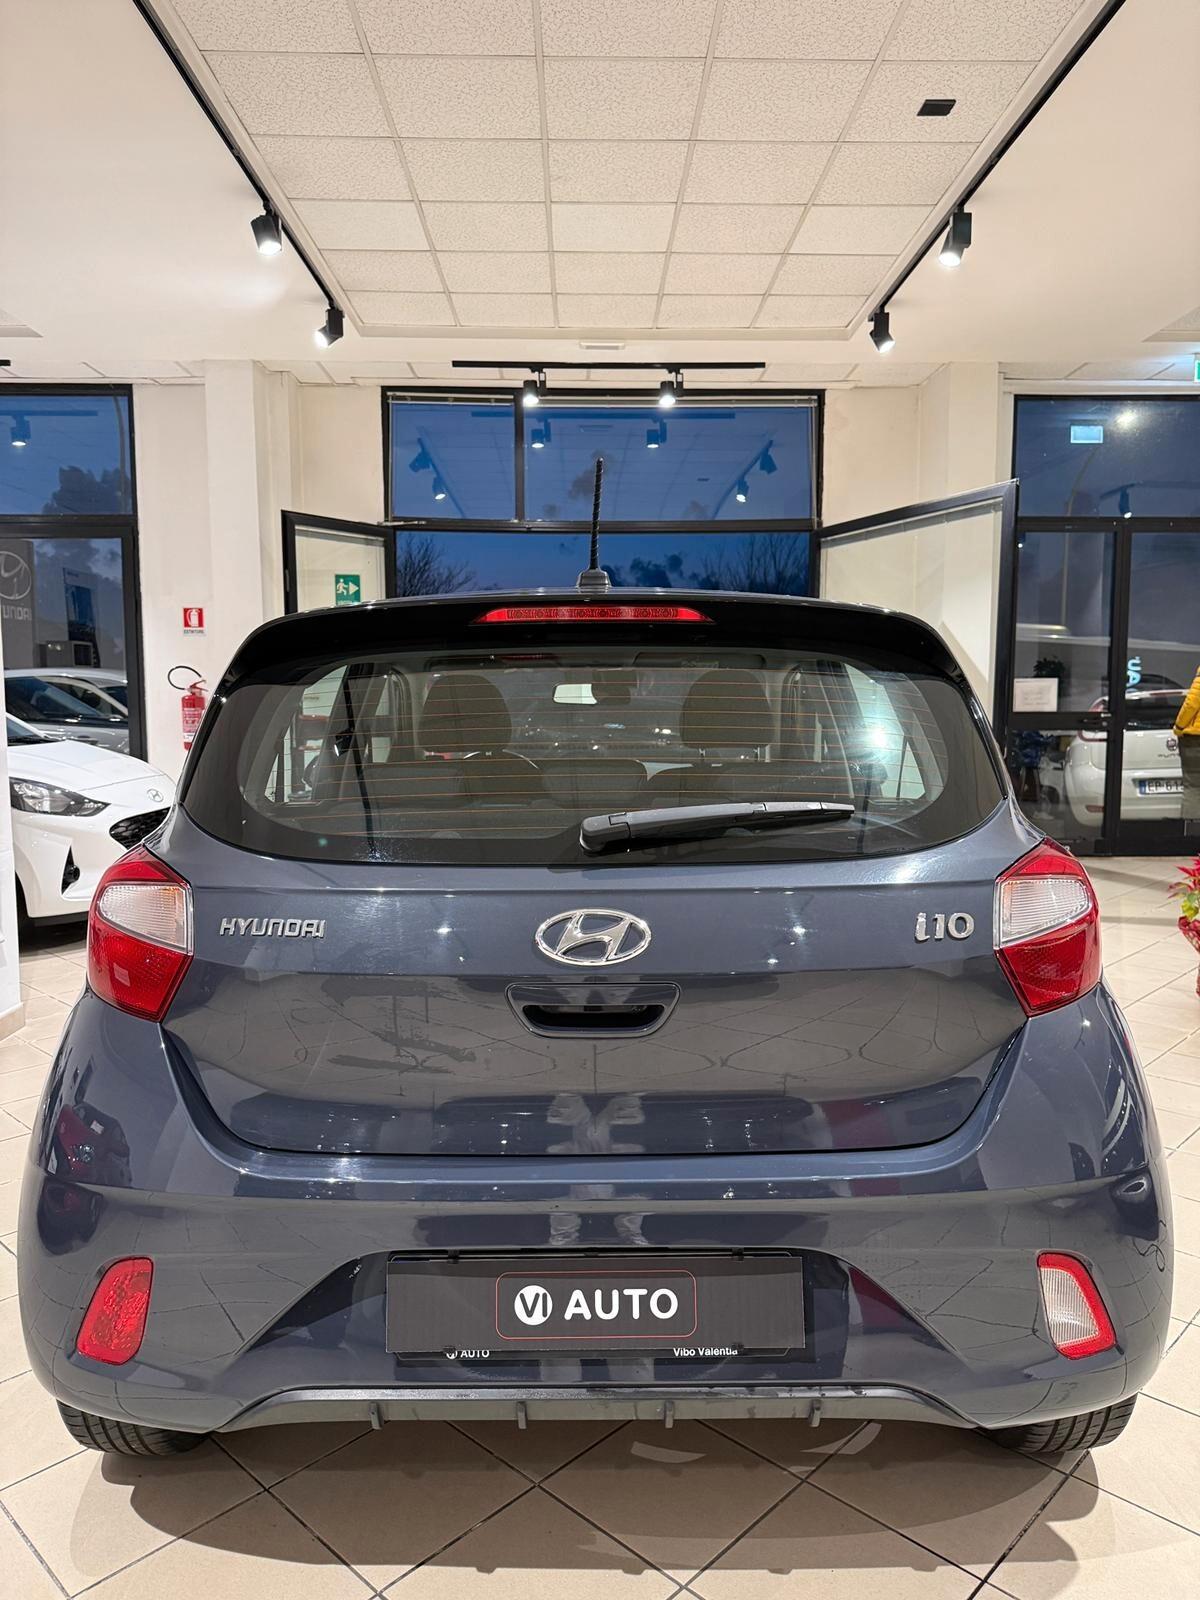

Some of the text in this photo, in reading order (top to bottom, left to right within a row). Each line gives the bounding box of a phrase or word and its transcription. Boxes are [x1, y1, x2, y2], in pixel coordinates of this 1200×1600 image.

[219, 918, 326, 938] HYUNDAI
[914, 912, 975, 941] i10
[517, 1288, 678, 1320] VI AUTO
[460, 1350, 490, 1358] AUTO
[673, 1347, 738, 1357] Vibo Valentia
